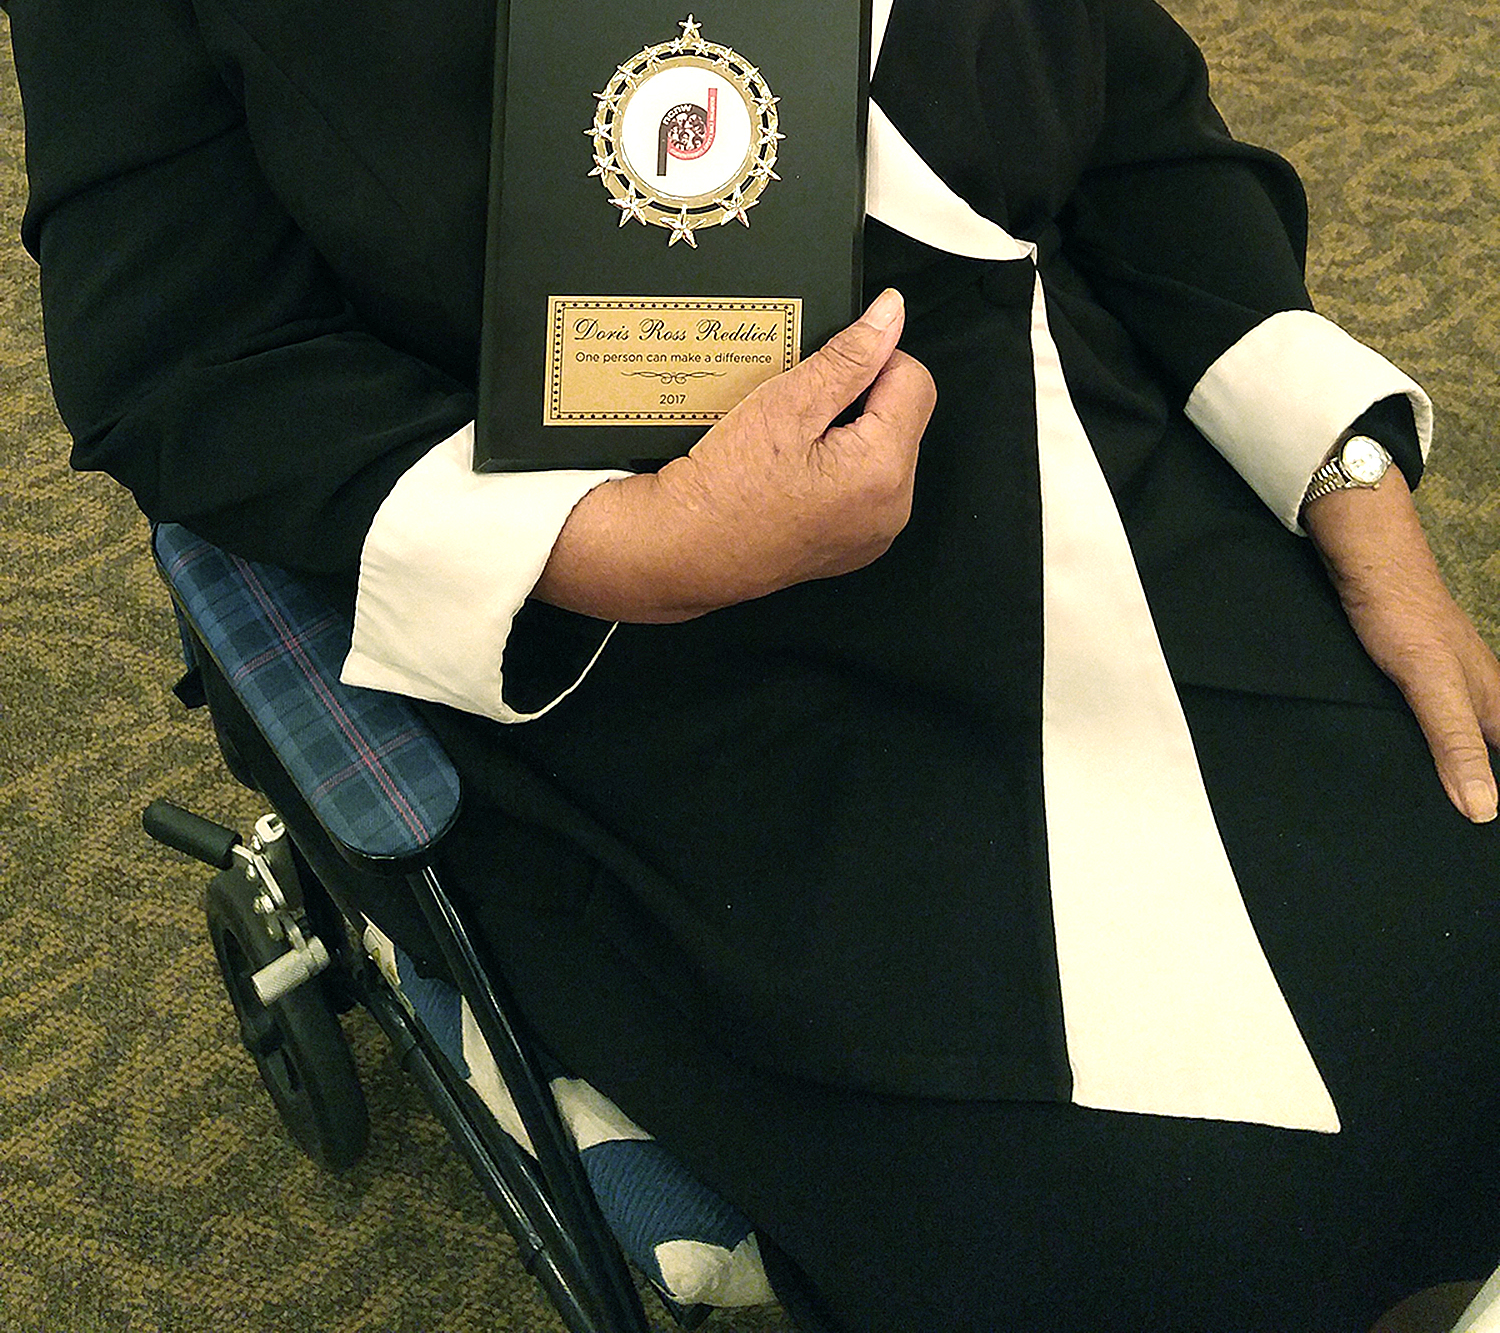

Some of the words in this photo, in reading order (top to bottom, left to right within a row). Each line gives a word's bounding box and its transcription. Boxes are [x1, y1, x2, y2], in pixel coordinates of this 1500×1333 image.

[572, 318, 630, 341] Doris
[638, 318, 687, 341] Ross
[695, 319, 778, 342] Reddick
[575, 351, 600, 363] One
[603, 353, 643, 365] person
[646, 353, 667, 363] can
[670, 352, 702, 363] make
[704, 354, 712, 363] a
[714, 352, 772, 364] difference
[659, 394, 687, 405] 2017
